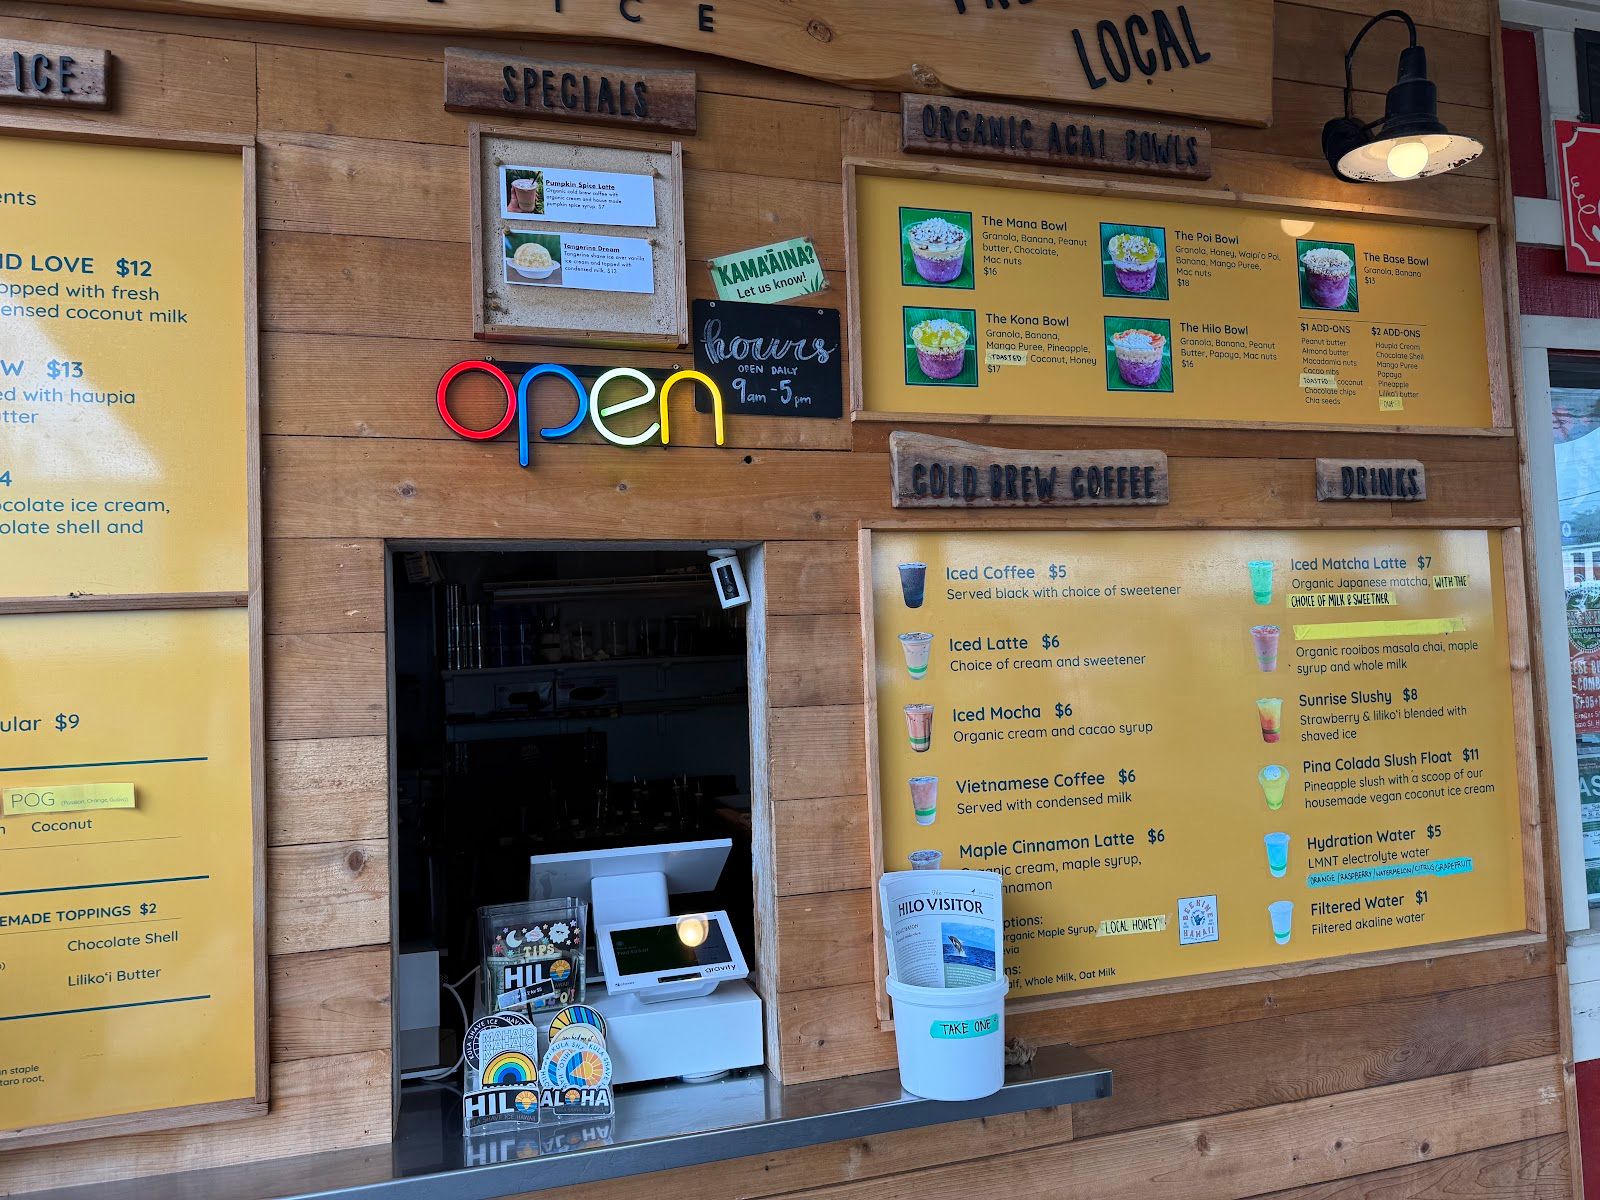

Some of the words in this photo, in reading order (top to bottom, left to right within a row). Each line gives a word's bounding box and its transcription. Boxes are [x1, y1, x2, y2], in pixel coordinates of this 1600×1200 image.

[1071, 5, 1211, 90] LOCAL
[12, 52, 76, 93] ICE
[502, 65, 648, 118] SPECIALS
[921, 104, 1034, 149] ORGANIC
[1049, 121, 1106, 159] ACAI
[1125, 129, 1198, 166] BOWLS
[545, 180, 576, 188] Pumpkin
[579, 182, 596, 190] Spice
[982, 215, 1003, 228] The
[1006, 218, 1038, 230] Mana
[1041, 220, 1067, 231] Bowl
[982, 231, 1018, 243] Granola,
[1021, 234, 1055, 246] Banana,
[1058, 237, 1087, 247] Peanut
[1175, 231, 1194, 242] The
[1196, 232, 1212, 243] Poi
[1214, 234, 1239, 245] Bowl
[564, 244, 596, 252] Tangerine
[0, 254, 22, 270] D
[31, 255, 94, 274] LOVE
[116, 258, 152, 278] $12
[983, 254, 1001, 264] Mac
[1003, 257, 1022, 266] nuts
[1364, 252, 1380, 262] The
[1384, 254, 1403, 264] Base
[1408, 256, 1428, 266] Bowl
[1395, 269, 1421, 277] Banana
[66, 285, 105, 299] with
[112, 286, 159, 301] fresh
[737, 288, 756, 299] Let
[758, 284, 771, 293] us
[773, 272, 807, 289] know!
[1, 304, 59, 318] ensed
[66, 308, 143, 321] coconut
[150, 309, 187, 323] milk
[986, 313, 1007, 324] The
[1010, 314, 1041, 325] Kona
[1044, 316, 1069, 327] Bowl
[986, 329, 1022, 341] Granola,
[1025, 331, 1060, 341] Banana,
[1180, 322, 1199, 333] The
[1201, 324, 1222, 334] Hilo
[1224, 325, 1248, 336] Bowl
[1301, 323, 1309, 332] $1
[1312, 324, 1350, 333] ADD-ONS
[1372, 327, 1381, 336] $2
[1384, 329, 1420, 338] ADD-ONS
[700, 318, 838, 364] hours
[1302, 338, 1325, 346] Peanut
[1302, 348, 1327, 356] Almond
[738, 365, 764, 373] OPEN
[771, 366, 798, 375] DAILY
[23, 388, 63, 403] with
[70, 389, 135, 406] haupia
[732, 378, 766, 403] 9am
[1305, 387, 1338, 395] Chocolate
[436, 360, 724, 468] open
[912, 463, 977, 498] COLD
[989, 463, 1057, 499] BREW
[1070, 465, 1155, 498] COFFEE
[1342, 467, 1418, 497] DRINKS
[0, 499, 64, 513] colate
[71, 499, 97, 511] ice
[104, 500, 170, 514] cream,
[56, 520, 100, 534] shell
[107, 520, 143, 534] and
[1291, 558, 1318, 571] Iced
[1322, 558, 1369, 570] Matcha
[1373, 558, 1407, 569] Latte
[1417, 556, 1432, 570] $7
[946, 567, 978, 581] Iced
[984, 566, 1035, 580] Coffee
[1049, 564, 1067, 580] $5
[950, 638, 982, 651] Iced
[987, 637, 1028, 650] Latte
[1042, 634, 1060, 650] $6
[1297, 664, 1327, 675] syrup
[1331, 662, 1350, 671] and
[1354, 660, 1383, 670] whole
[1387, 659, 1407, 669] milk
[1299, 693, 1347, 706] Sunrise
[1351, 690, 1392, 705] Slushy
[1403, 688, 1418, 702] $8
[953, 708, 985, 722] Iced
[990, 705, 1040, 720] Mocha
[1055, 703, 1073, 718] $6
[954, 729, 1004, 744] Organic
[1008, 728, 1047, 739] cream
[1051, 726, 1074, 737] and
[1079, 724, 1116, 736] cacao
[1119, 722, 1153, 734] syrup
[1301, 731, 1339, 742] shaved
[1342, 730, 1357, 739] ice
[1303, 761, 1331, 773] Pina
[1335, 757, 1380, 771] Colada
[1385, 754, 1417, 768] Slush
[1421, 751, 1452, 764] Float
[1463, 748, 1479, 762] $11
[955, 777, 1049, 794] Vietnamese
[1054, 772, 1105, 787] Coffee
[1118, 769, 1136, 784] $6
[11, 792, 55, 808] POG
[957, 801, 1002, 815] Served
[1006, 798, 1032, 811] with
[1036, 795, 1103, 809] condensed
[1107, 792, 1132, 803] milk
[32, 819, 93, 832] Coconut
[959, 842, 1007, 860] Maple
[1012, 835, 1089, 854] Cinnamon
[1094, 832, 1135, 847] Latte
[1147, 829, 1165, 844] $6
[1307, 833, 1373, 851] Hydration
[1377, 829, 1415, 842] Water
[1427, 825, 1441, 839] $5
[1309, 856, 1339, 868] LMNT
[1342, 851, 1398, 866] electrolyte
[1401, 848, 1429, 859] water
[899, 899, 925, 916] HILO
[927, 898, 983, 914] VISITOR
[1311, 898, 1361, 916] Filtered
[1365, 894, 1404, 908] Water
[1415, 890, 1428, 904] $1
[56, 905, 131, 922] TOPPINGS
[139, 903, 157, 916] $2
[67, 934, 141, 952] Chocolate
[144, 931, 179, 945] Shell
[524, 944, 555, 957] TIPS
[116, 967, 161, 982] Butter
[705, 964, 736, 974] gravity
[468, 1022, 485, 1040] SHAVE
[940, 1022, 969, 1035] TAKE
[974, 1019, 991, 1032] ONE
[10, 1065, 39, 1074] staple
